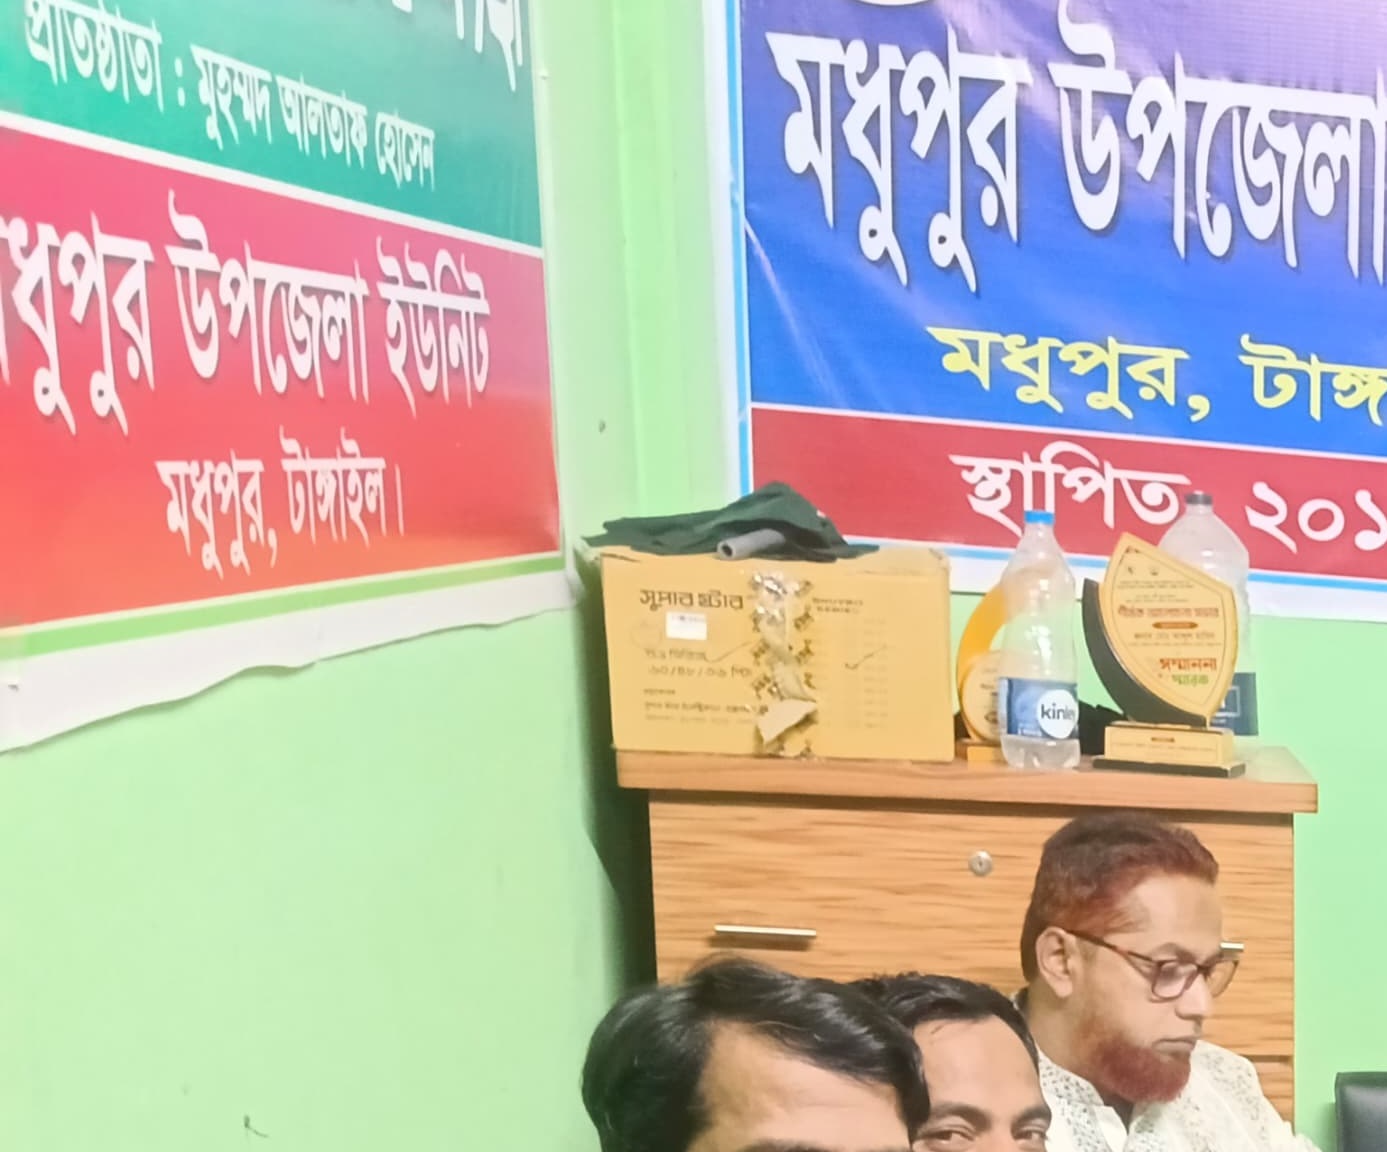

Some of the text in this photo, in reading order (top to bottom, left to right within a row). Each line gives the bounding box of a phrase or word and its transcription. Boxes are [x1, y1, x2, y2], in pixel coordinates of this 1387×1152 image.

[275, 73, 368, 169] আলতাফ
[374, 111, 436, 192] হোসেন
[766, 22, 1034, 293] মধুপুর
[165, 189, 370, 404] উপজেলা
[376, 235, 491, 418] ইউনিট
[925, 325, 1210, 423] মধুপুর,
[154, 448, 278, 580] মধুপুর,
